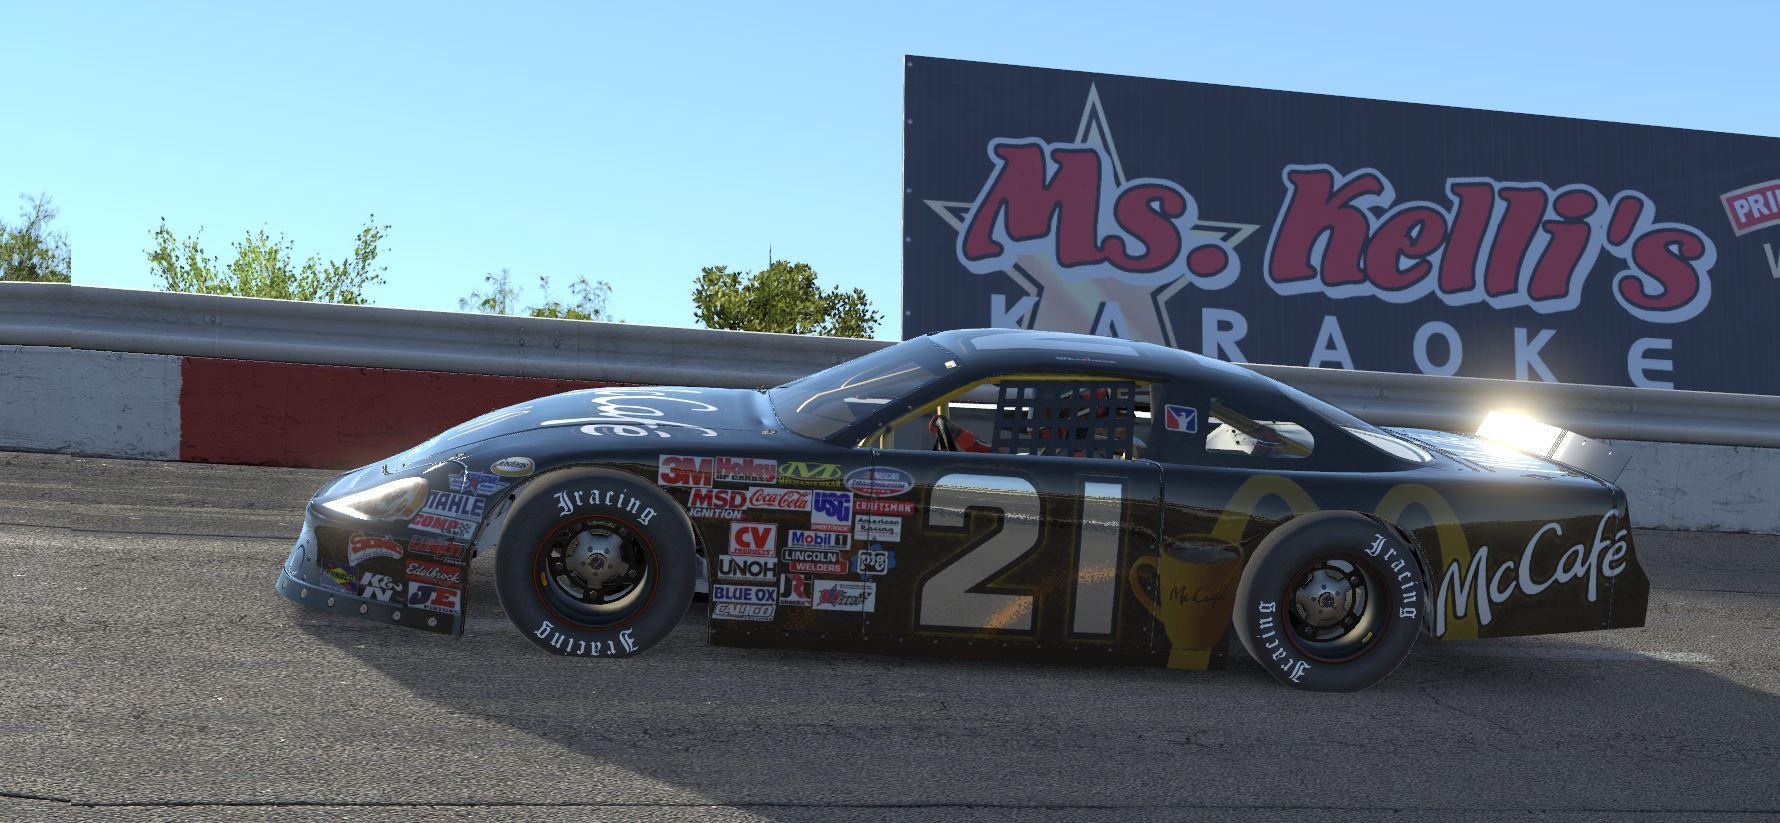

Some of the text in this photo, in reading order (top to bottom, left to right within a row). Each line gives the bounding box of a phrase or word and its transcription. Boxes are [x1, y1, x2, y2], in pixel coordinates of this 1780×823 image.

[959, 138, 1714, 318] Ms. Kelli's
[991, 294, 1674, 389] KARAOKE
[661, 456, 713, 487] 3M
[716, 456, 776, 482] Holley
[691, 489, 747, 509] MSD
[814, 492, 851, 522] USG
[856, 501, 912, 513] CRAFTSMAN
[689, 508, 742, 519] IGNITION
[857, 518, 900, 526] American
[735, 527, 772, 549] CV
[792, 532, 831, 545] Mobil
[860, 525, 894, 535] Racing
[785, 551, 837, 562] LINCOLN
[920, 473, 1122, 634] 21
[406, 563, 461, 583] Edelbrock
[719, 558, 776, 577] UNOH
[796, 562, 841, 572] WELDERS
[1435, 509, 1628, 638] McCafé
[360, 572, 402, 602] K&N
[408, 585, 457, 609] JE
[714, 587, 776, 602] BLUE OX
